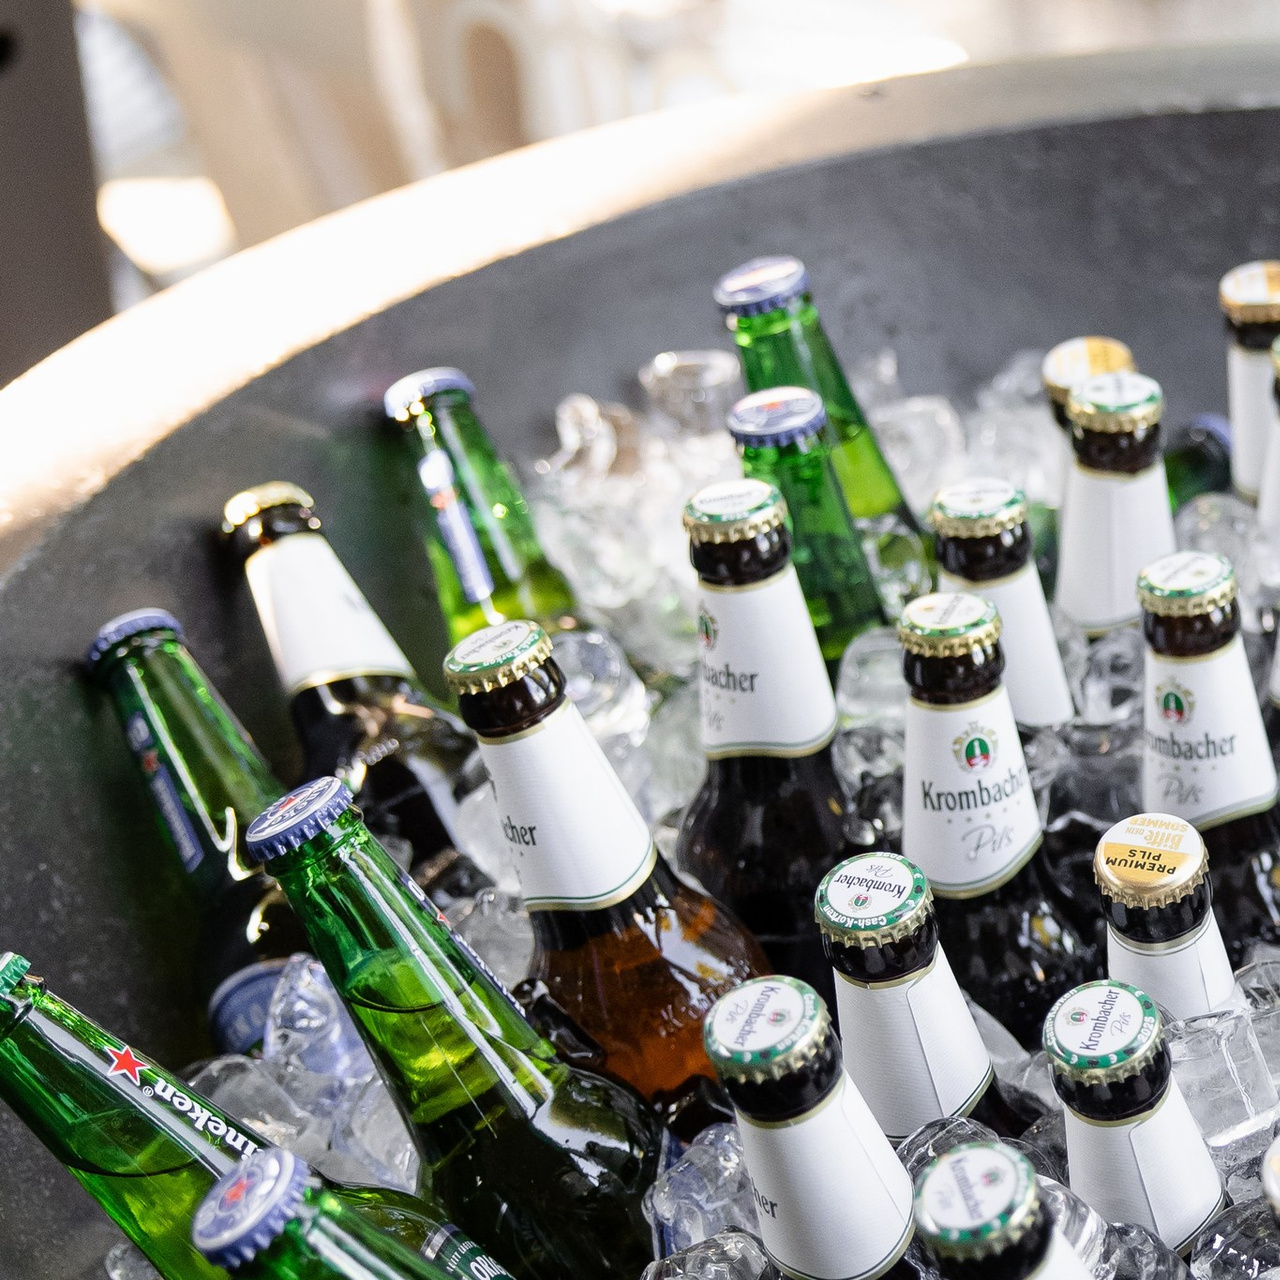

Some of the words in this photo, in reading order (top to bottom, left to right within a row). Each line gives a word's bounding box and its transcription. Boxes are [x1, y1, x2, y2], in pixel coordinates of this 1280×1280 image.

[1125, 826, 1145, 836] DEIN
[1129, 817, 1190, 833] SOMMER
[1105, 856, 1177, 875] PREMIUM
[1128, 849, 1162, 862] PILS
[866, 864, 894, 879] Pils
[834, 873, 907, 900] Krombacher
[823, 904, 888, 929] Cash-Korken
[734, 984, 781, 1047] Krombacher
[1045, 988, 1078, 1046] Cash-Korken
[1079, 988, 1121, 1052] Krombacher
[1110, 1011, 1132, 1037] Pils
[153, 1077, 266, 1161] ineken
